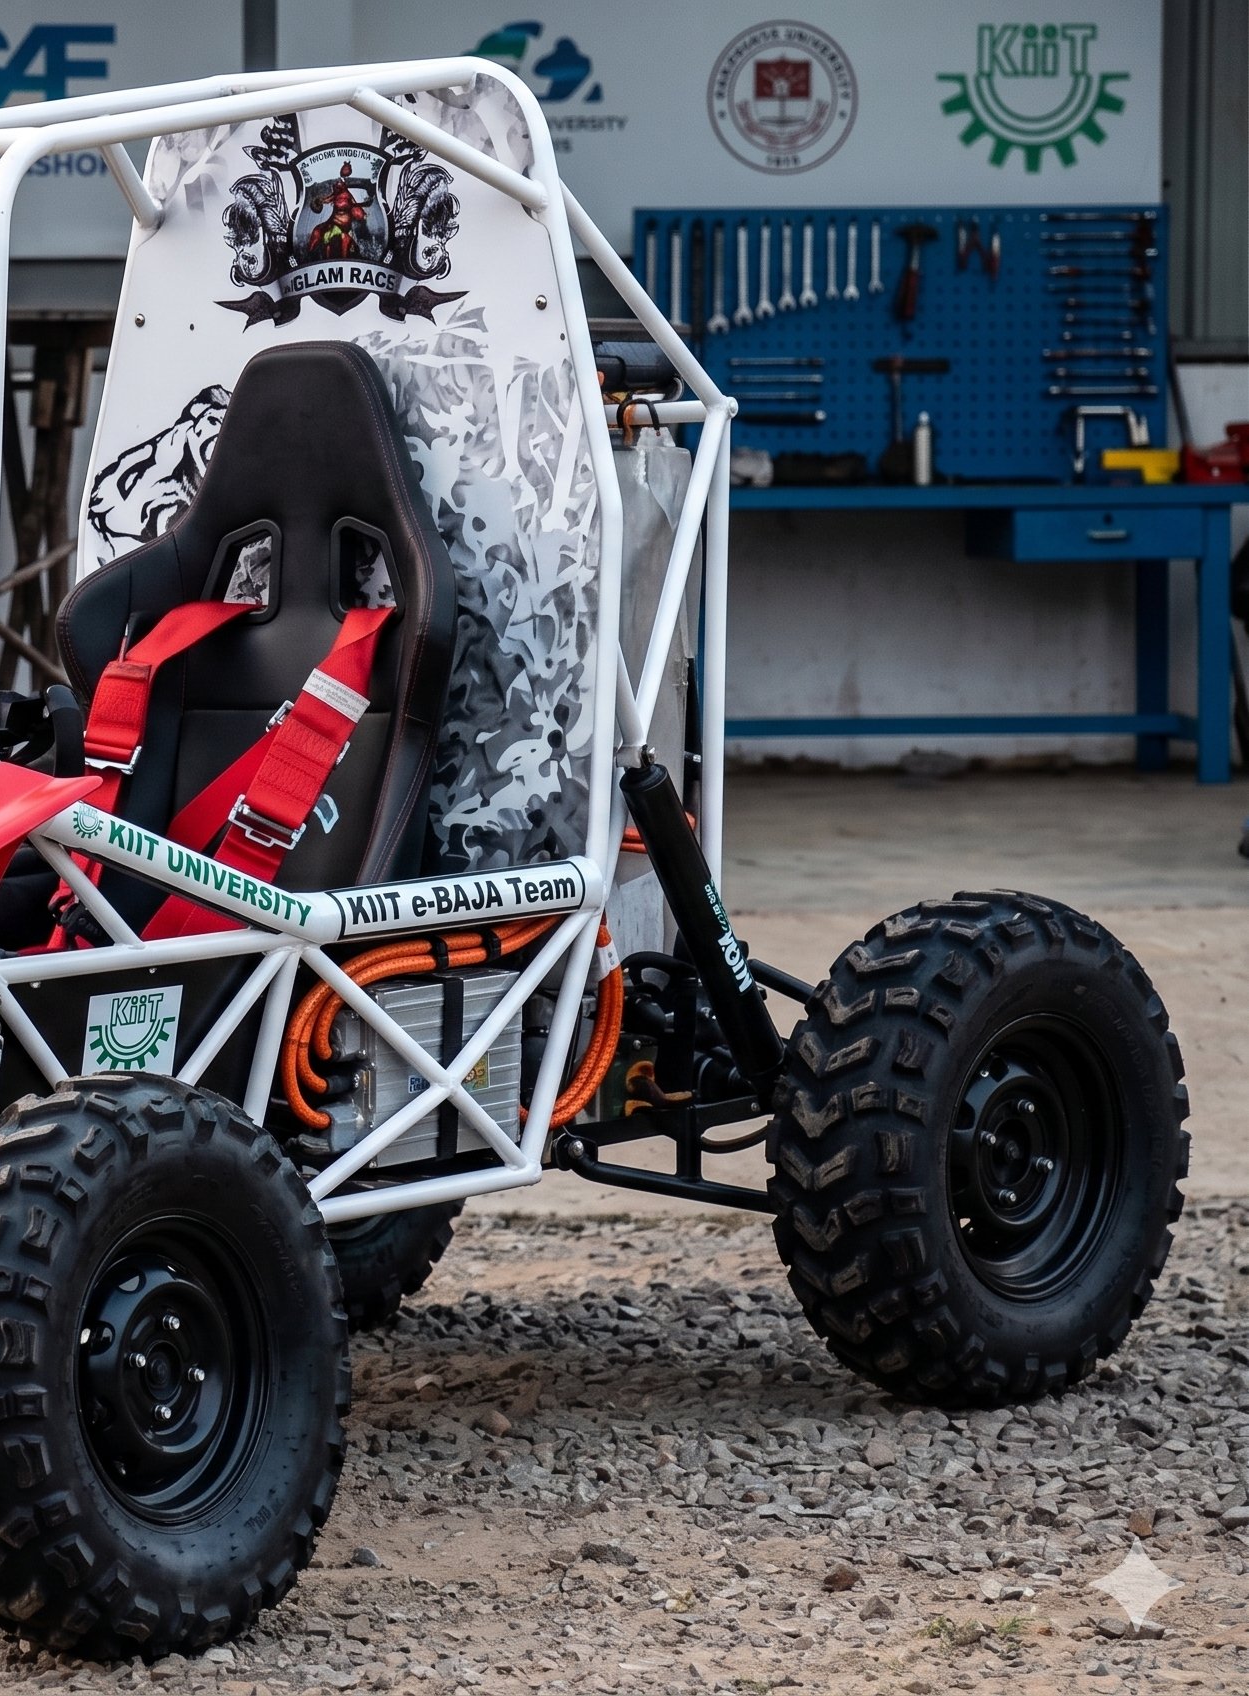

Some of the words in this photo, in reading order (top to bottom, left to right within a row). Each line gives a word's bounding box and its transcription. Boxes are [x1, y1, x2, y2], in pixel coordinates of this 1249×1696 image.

[108, 820, 160, 861] KIIT
[167, 846, 312, 926] UNIVERSITY
[347, 891, 402, 925] KIIT
[412, 880, 503, 916] e-BAJA
[505, 876, 576, 905] Team
